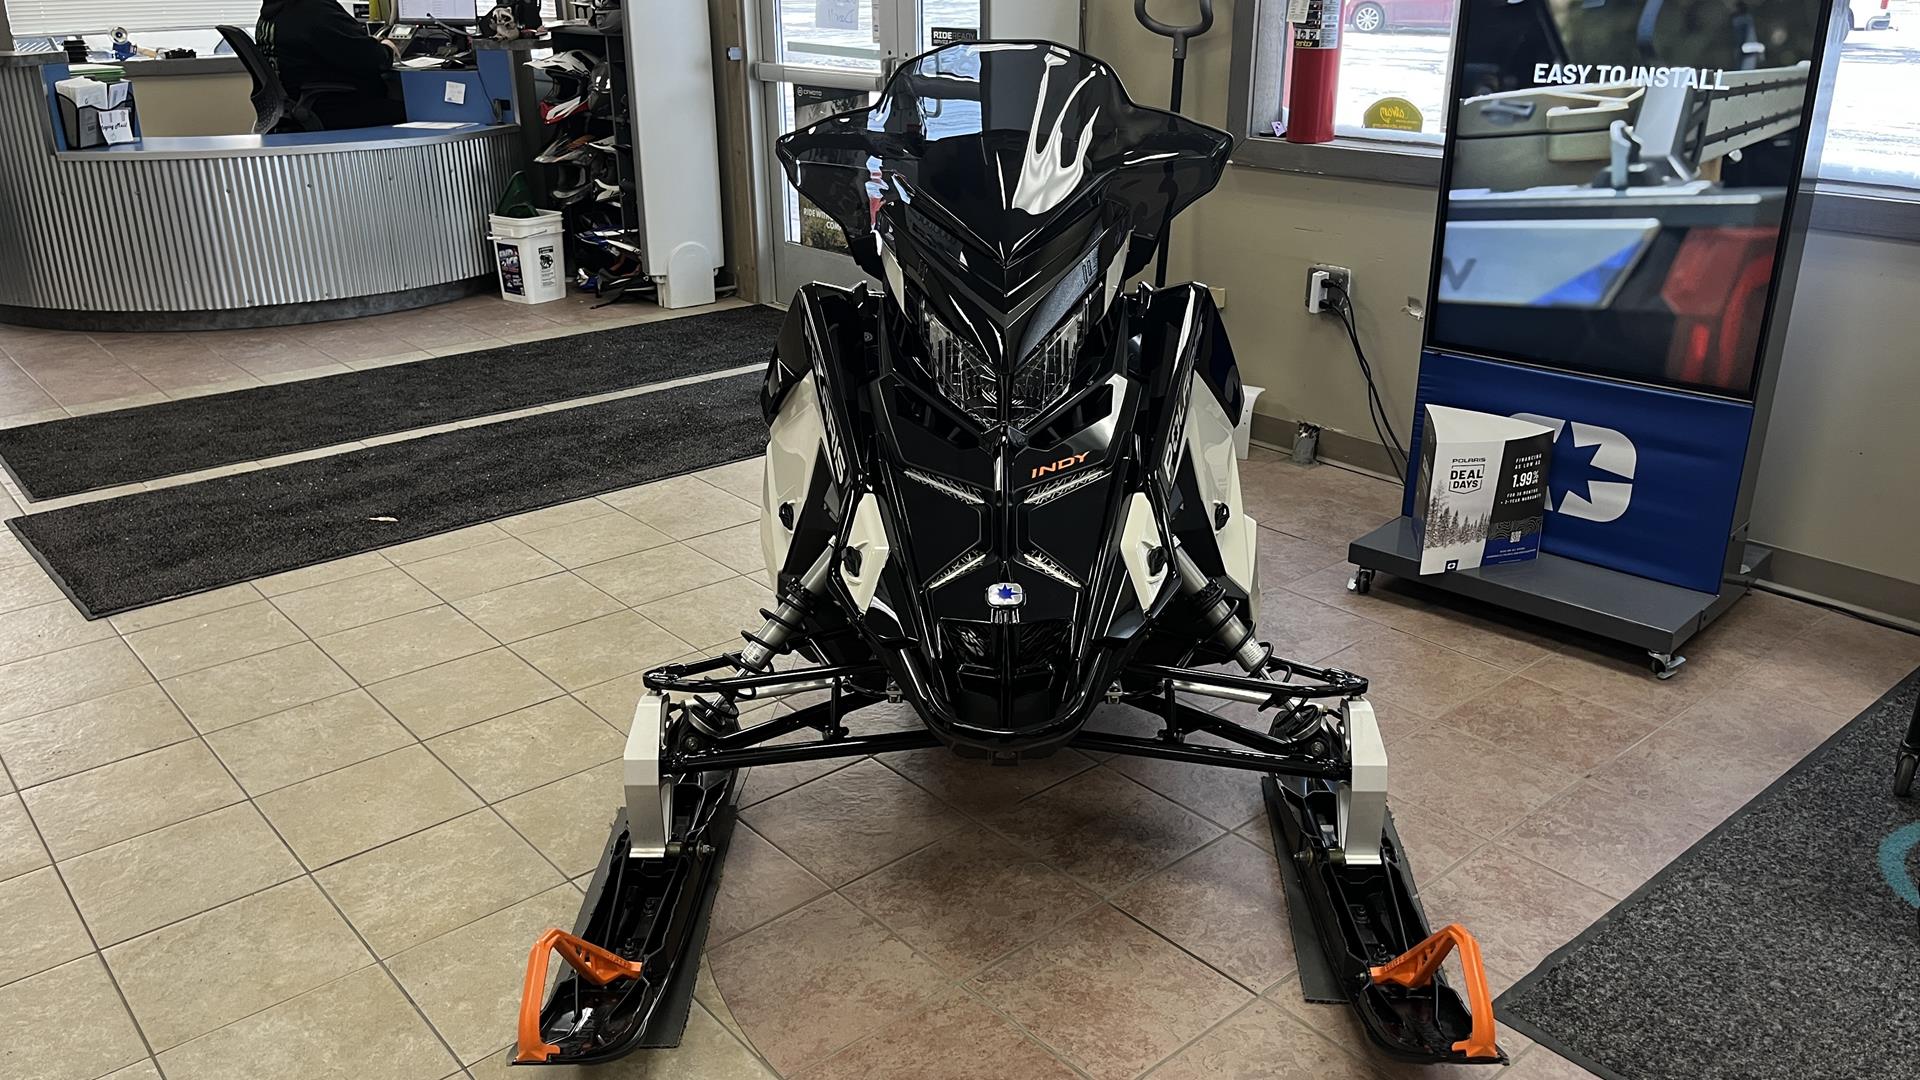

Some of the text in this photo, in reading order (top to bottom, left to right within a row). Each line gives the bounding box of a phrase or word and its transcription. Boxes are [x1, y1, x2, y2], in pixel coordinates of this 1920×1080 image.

[1533, 63, 1730, 91] EASY TO INSTALL
[803, 207, 816, 217] RIDE
[1515, 453, 1542, 464] FINANCING
[1031, 450, 1090, 479] INDY
[1450, 469, 1484, 480] DEAL
[1452, 480, 1479, 489] DAYS
